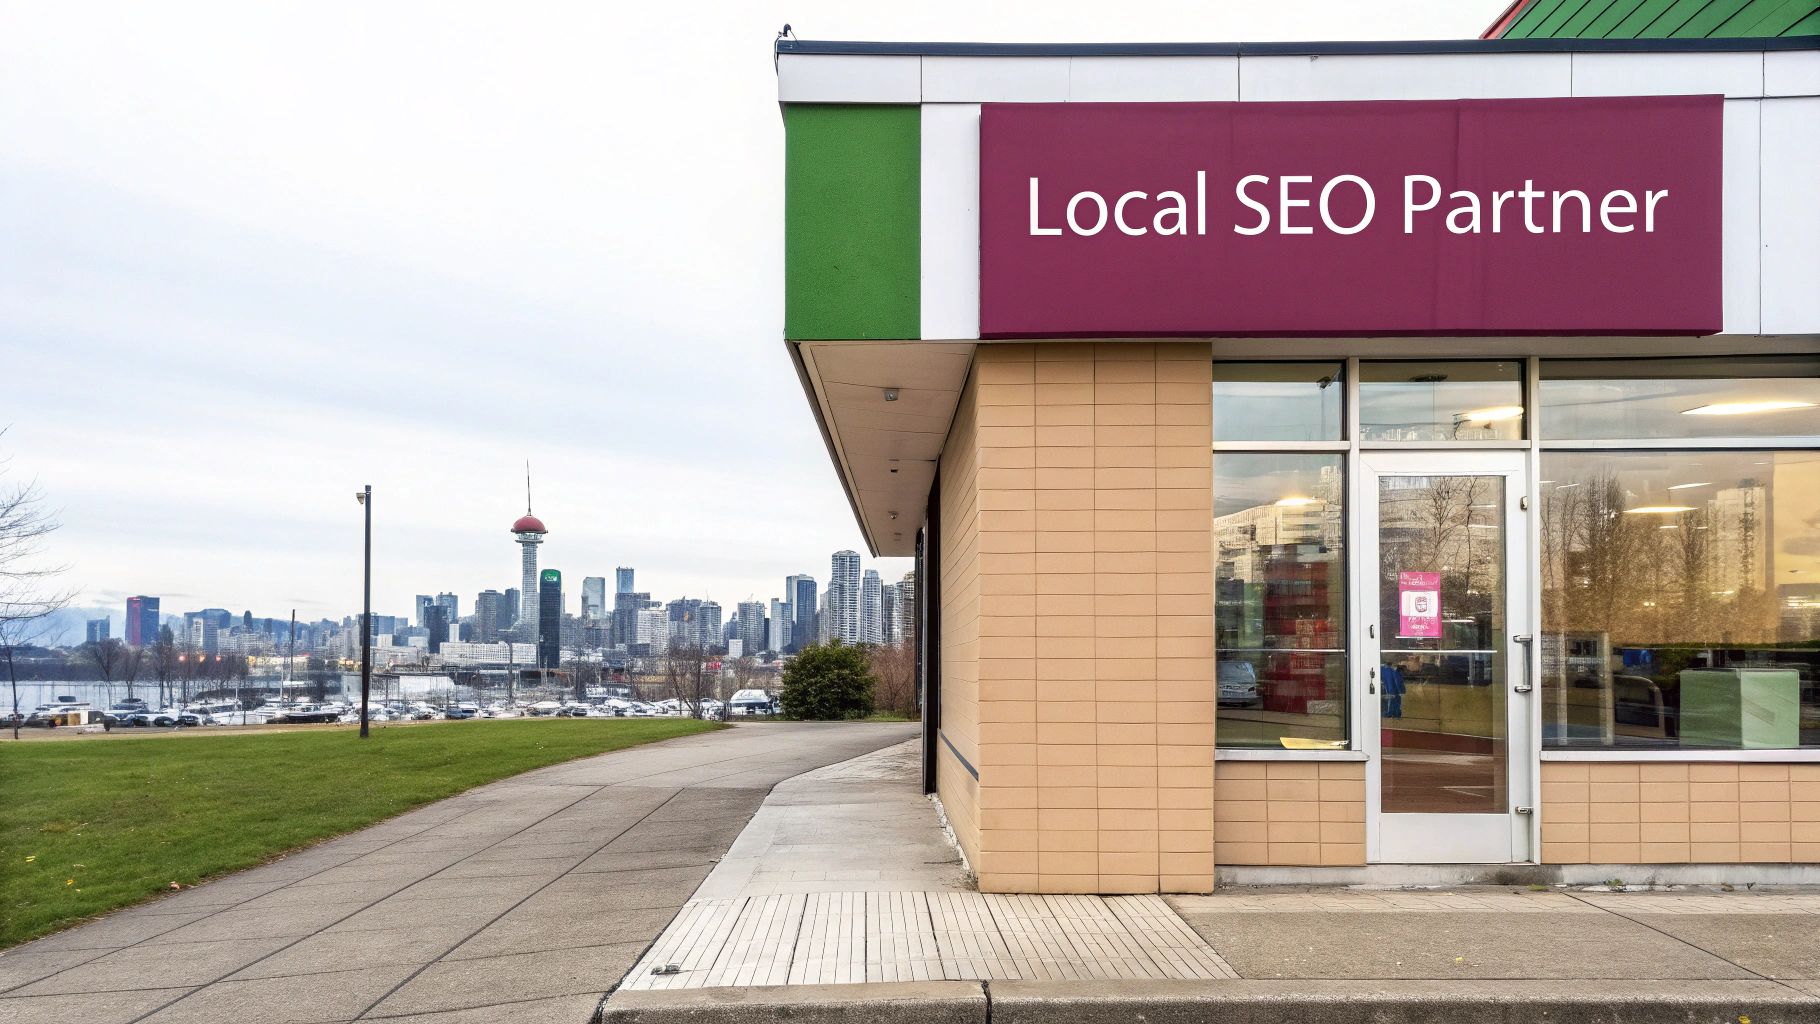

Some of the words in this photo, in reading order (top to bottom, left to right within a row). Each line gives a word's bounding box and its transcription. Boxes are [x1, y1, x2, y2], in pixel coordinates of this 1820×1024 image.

[1028, 170, 1207, 237] Local
[1232, 174, 1377, 236] SEO
[1403, 174, 1670, 235] Partner
